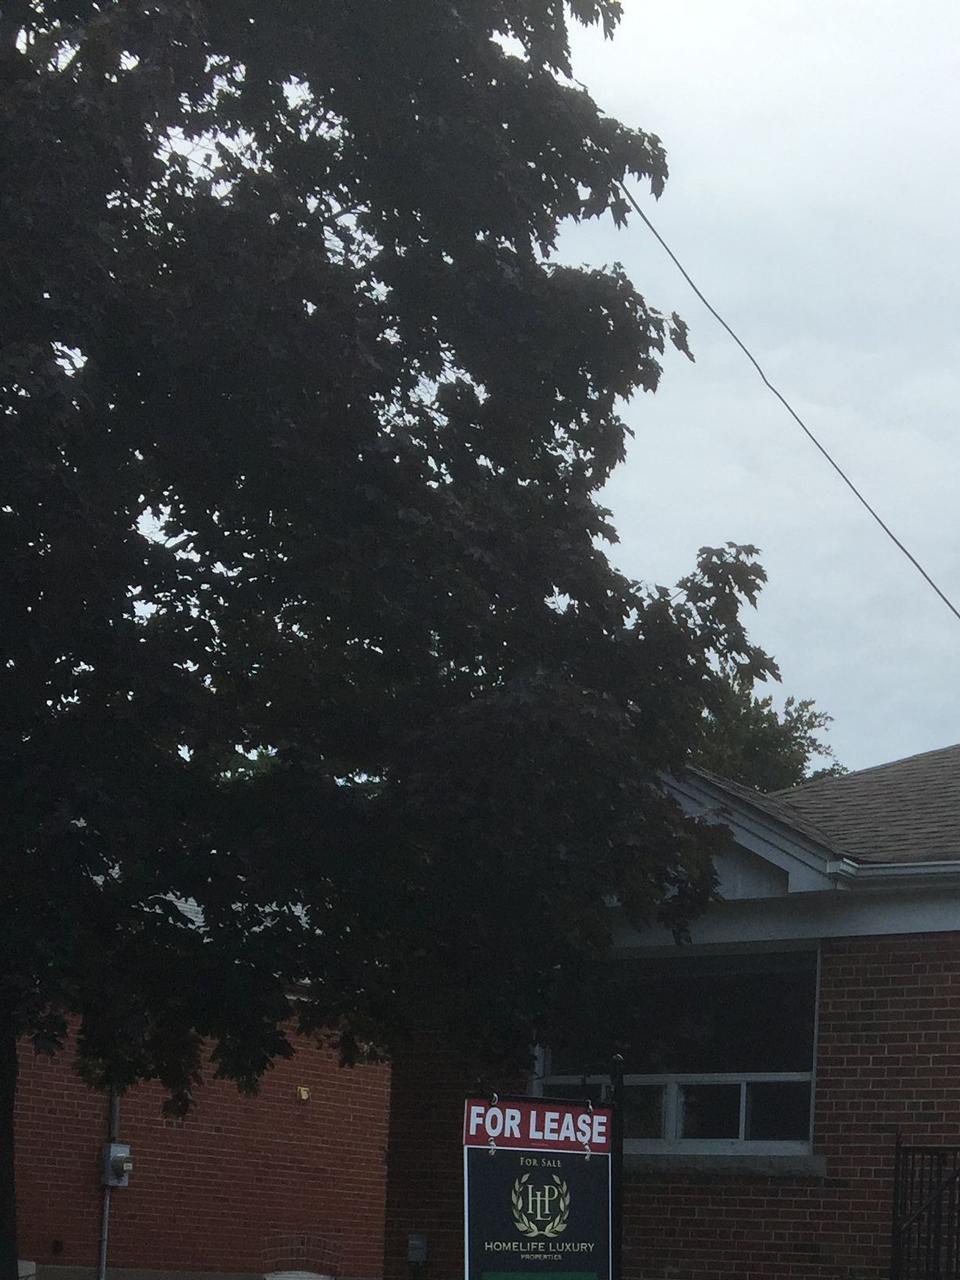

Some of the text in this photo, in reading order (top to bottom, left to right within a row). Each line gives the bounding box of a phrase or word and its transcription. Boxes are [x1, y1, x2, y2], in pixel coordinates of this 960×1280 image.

[469, 1106, 608, 1144] FOR LEASE
[520, 1157, 562, 1168] FOR SALE
[484, 1241, 595, 1252] HOMELIFE LUXURY
